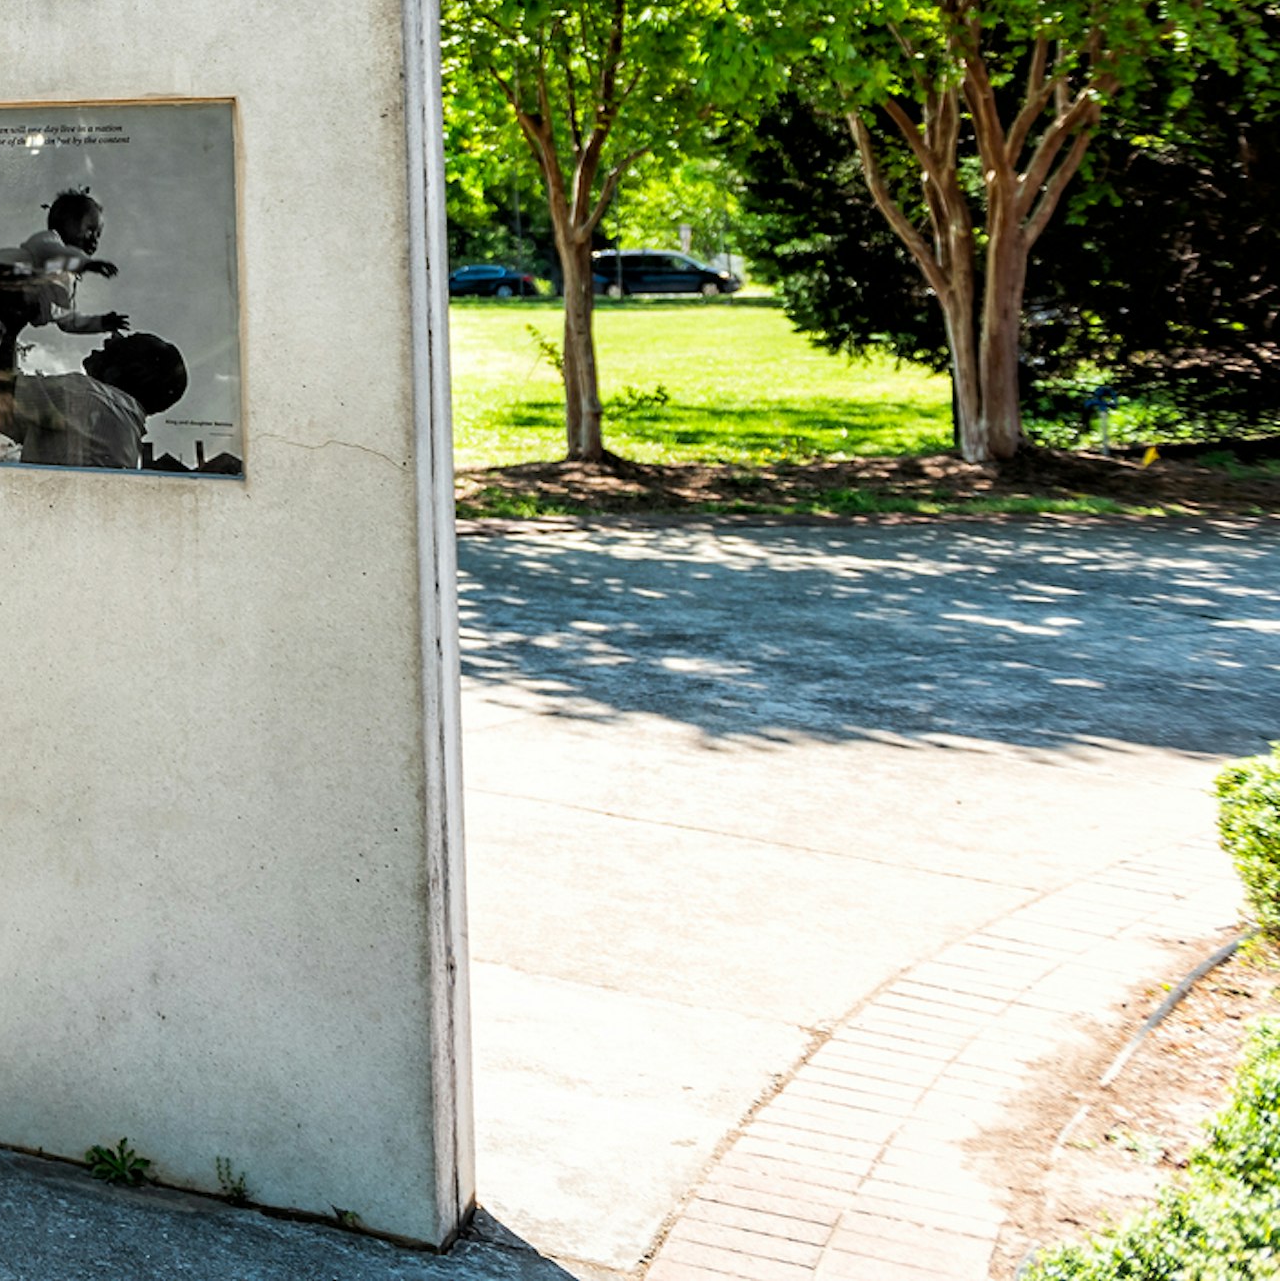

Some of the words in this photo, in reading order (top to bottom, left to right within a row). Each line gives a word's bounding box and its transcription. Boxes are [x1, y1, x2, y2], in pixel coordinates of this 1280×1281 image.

[10, 125, 26, 134] will
[44, 125, 59, 135] day
[60, 125, 75, 133] live
[95, 124, 122, 133] nation
[8, 136, 17, 148] of
[71, 136, 82, 147] by
[83, 136, 96, 144] the
[98, 135, 130, 144] content
